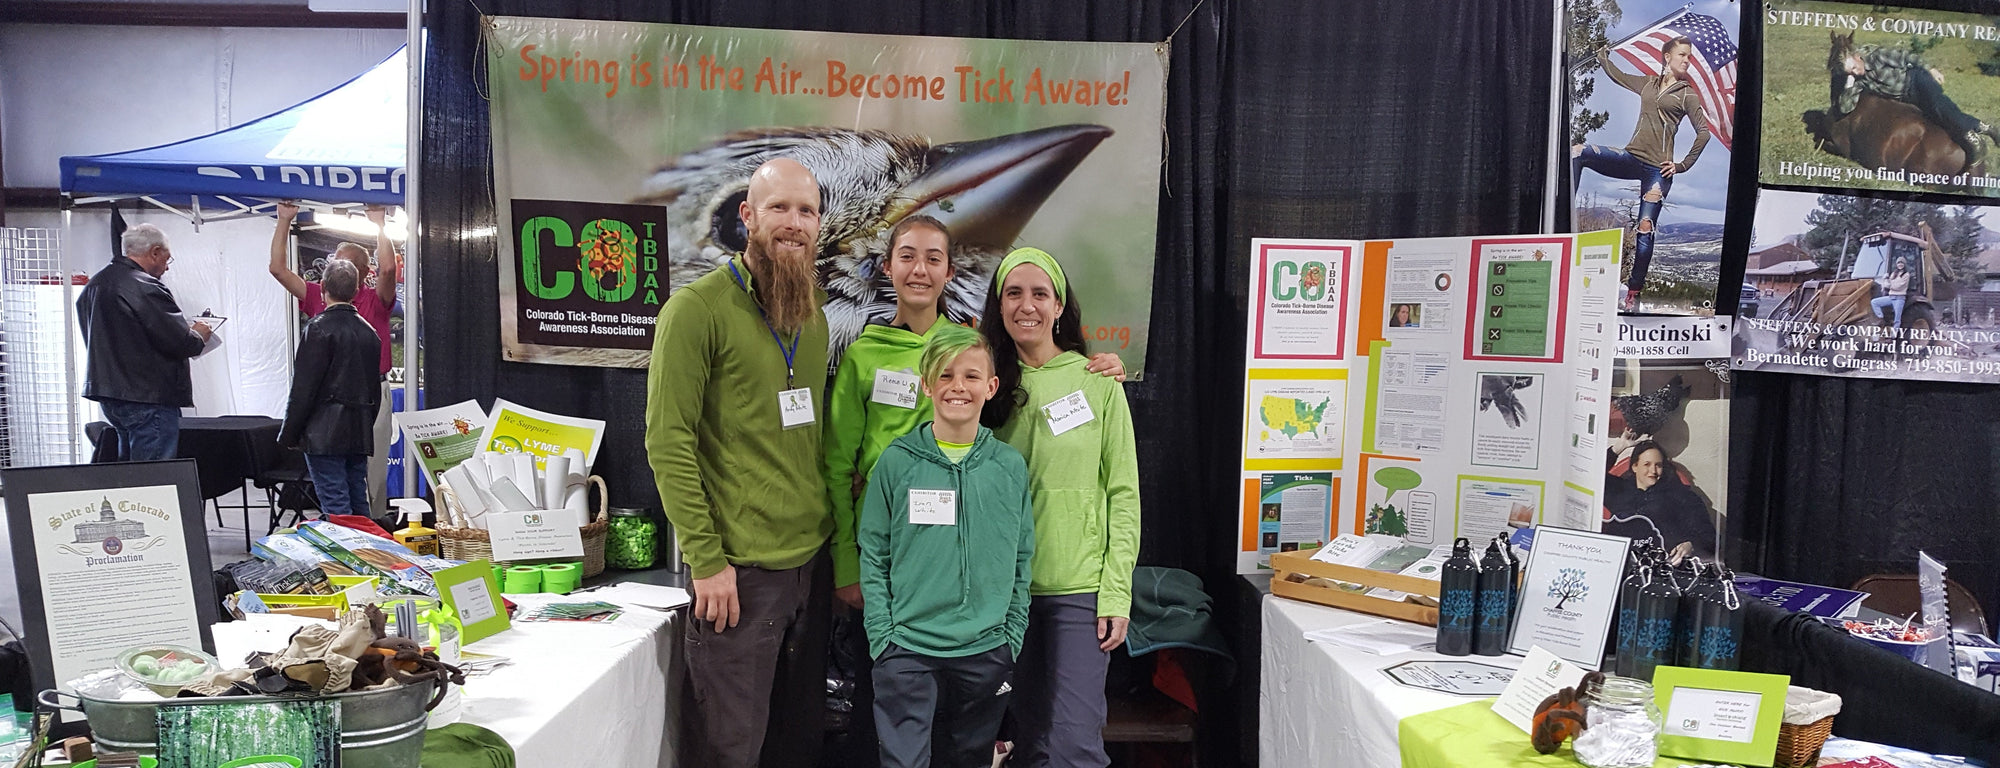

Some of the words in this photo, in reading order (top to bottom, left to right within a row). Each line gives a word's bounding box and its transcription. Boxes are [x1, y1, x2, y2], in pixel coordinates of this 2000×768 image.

[1767, 9, 1858, 30] STEFFENS
[1862, 16, 1876, 31] &
[1881, 18, 1970, 39] COMPANY
[519, 44, 620, 98] Spring
[630, 54, 652, 87] is
[662, 56, 689, 89] in
[698, 54, 744, 91] the
[954, 66, 1014, 103] Tick
[1023, 67, 1130, 107] Aware!
[1780, 161, 1841, 181] Helping
[1845, 167, 1872, 182] you
[1877, 166, 1905, 182] find
[1909, 171, 1949, 186] peace
[1953, 172, 1969, 186] of
[521, 216, 638, 303] CO
[1272, 260, 1327, 301] CO
[526, 309, 565, 321] Colorado
[567, 311, 619, 323] Tick-Borne
[621, 311, 657, 325] Disease
[539, 322, 588, 334] Awareness
[590, 323, 646, 336] Association
[1618, 323, 1711, 341] Plucinski
[1749, 317, 1821, 334] STEFFENS
[1823, 323, 1834, 334] &
[1837, 324, 1908, 339] COMPANY
[1910, 328, 1970, 343] REALTY,
[1667, 346, 1689, 355] Cell
[1791, 334, 1816, 349] We
[1820, 338, 1859, 352] work
[1864, 338, 1896, 353] hard
[1900, 341, 1922, 354] for
[1925, 343, 1957, 358] you!
[1747, 348, 1828, 367] Bernadette
[1833, 354, 1898, 372] Gingrass
[1905, 358, 2000, 376] 719-850-1993
[504, 414, 515, 424] We
[523, 437, 560, 454] LYME
[48, 508, 81, 531] State
[85, 503, 96, 513] of
[118, 500, 170, 521] Colorado
[1558, 542, 1584, 551] THANK
[1585, 546, 1602, 554] YOU
[85, 553, 144, 568] Proclamation
